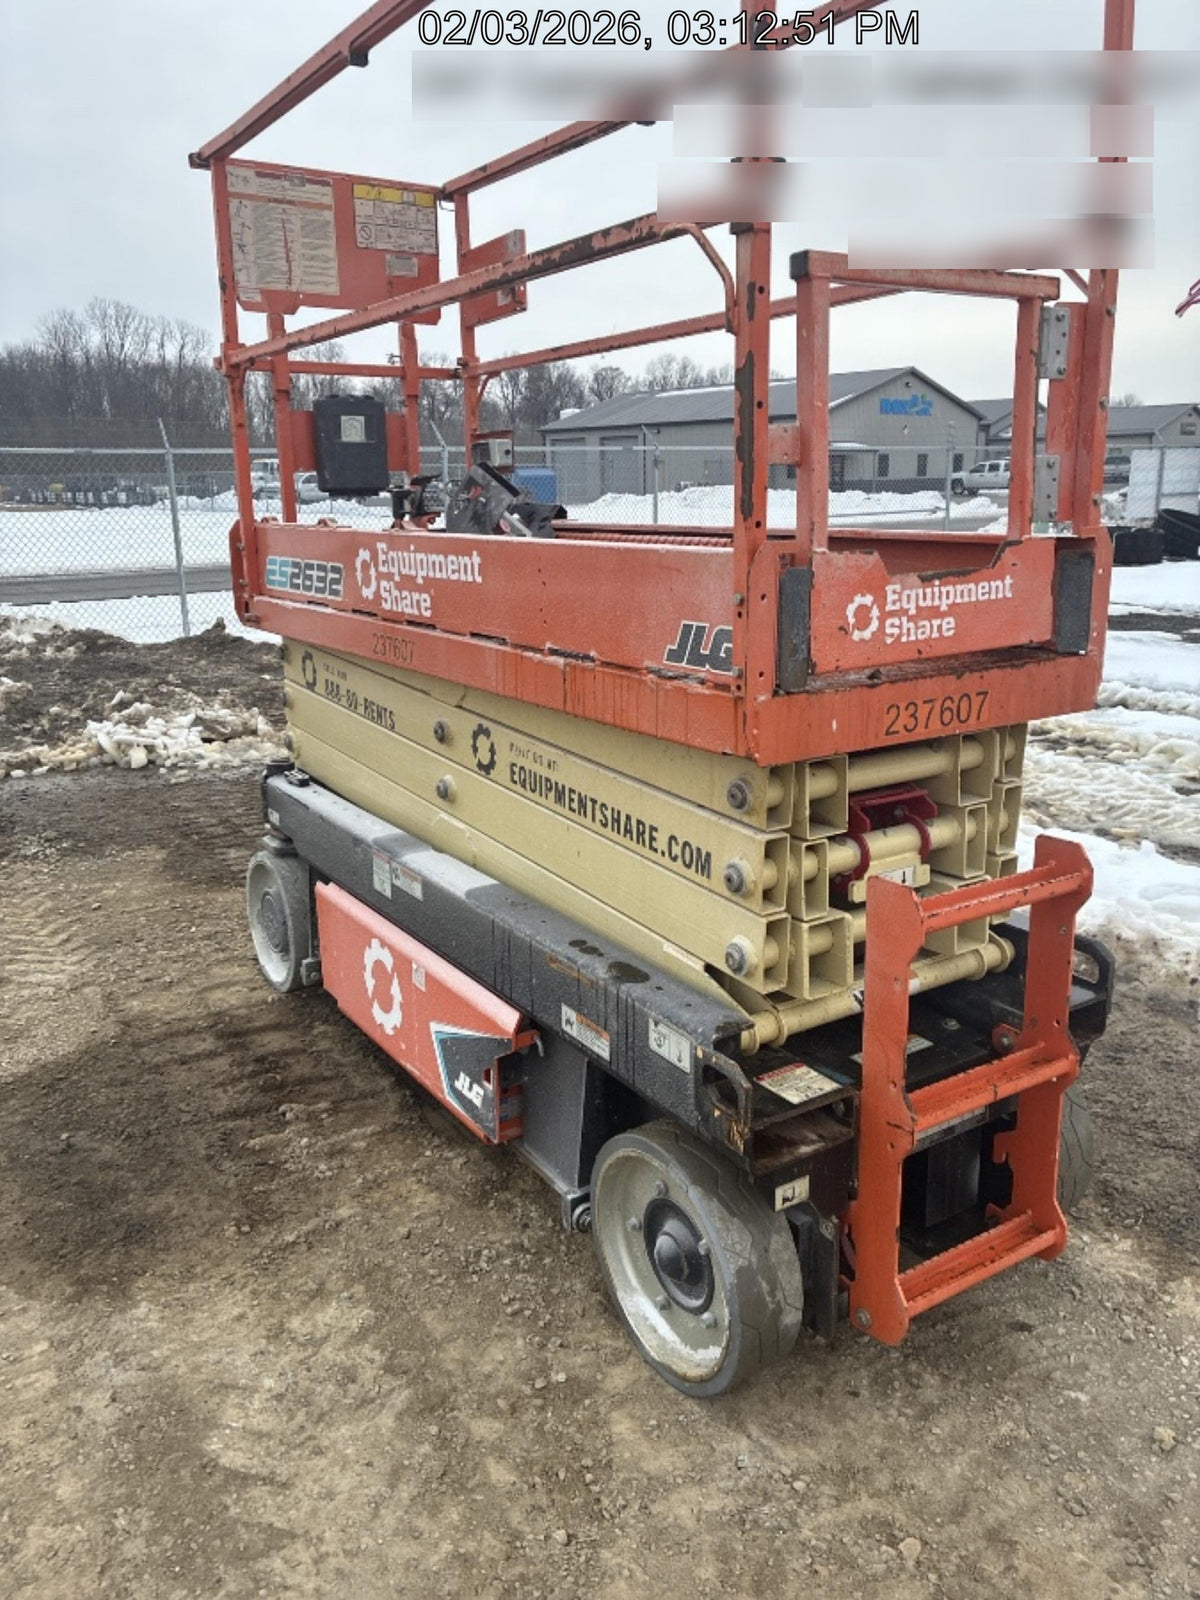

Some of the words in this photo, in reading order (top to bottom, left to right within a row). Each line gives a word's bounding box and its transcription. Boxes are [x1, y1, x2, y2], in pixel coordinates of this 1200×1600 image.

[376, 541, 483, 584] Equipment
[379, 580, 432, 617] Share
[885, 575, 1014, 615] Equipment
[372, 632, 415, 663] 237607
[884, 616, 956, 645] Share
[884, 690, 990, 737] 237607
[509, 762, 713, 880] EQUIPMENTSHARE.COM
[454, 1070, 485, 1109] JLG
